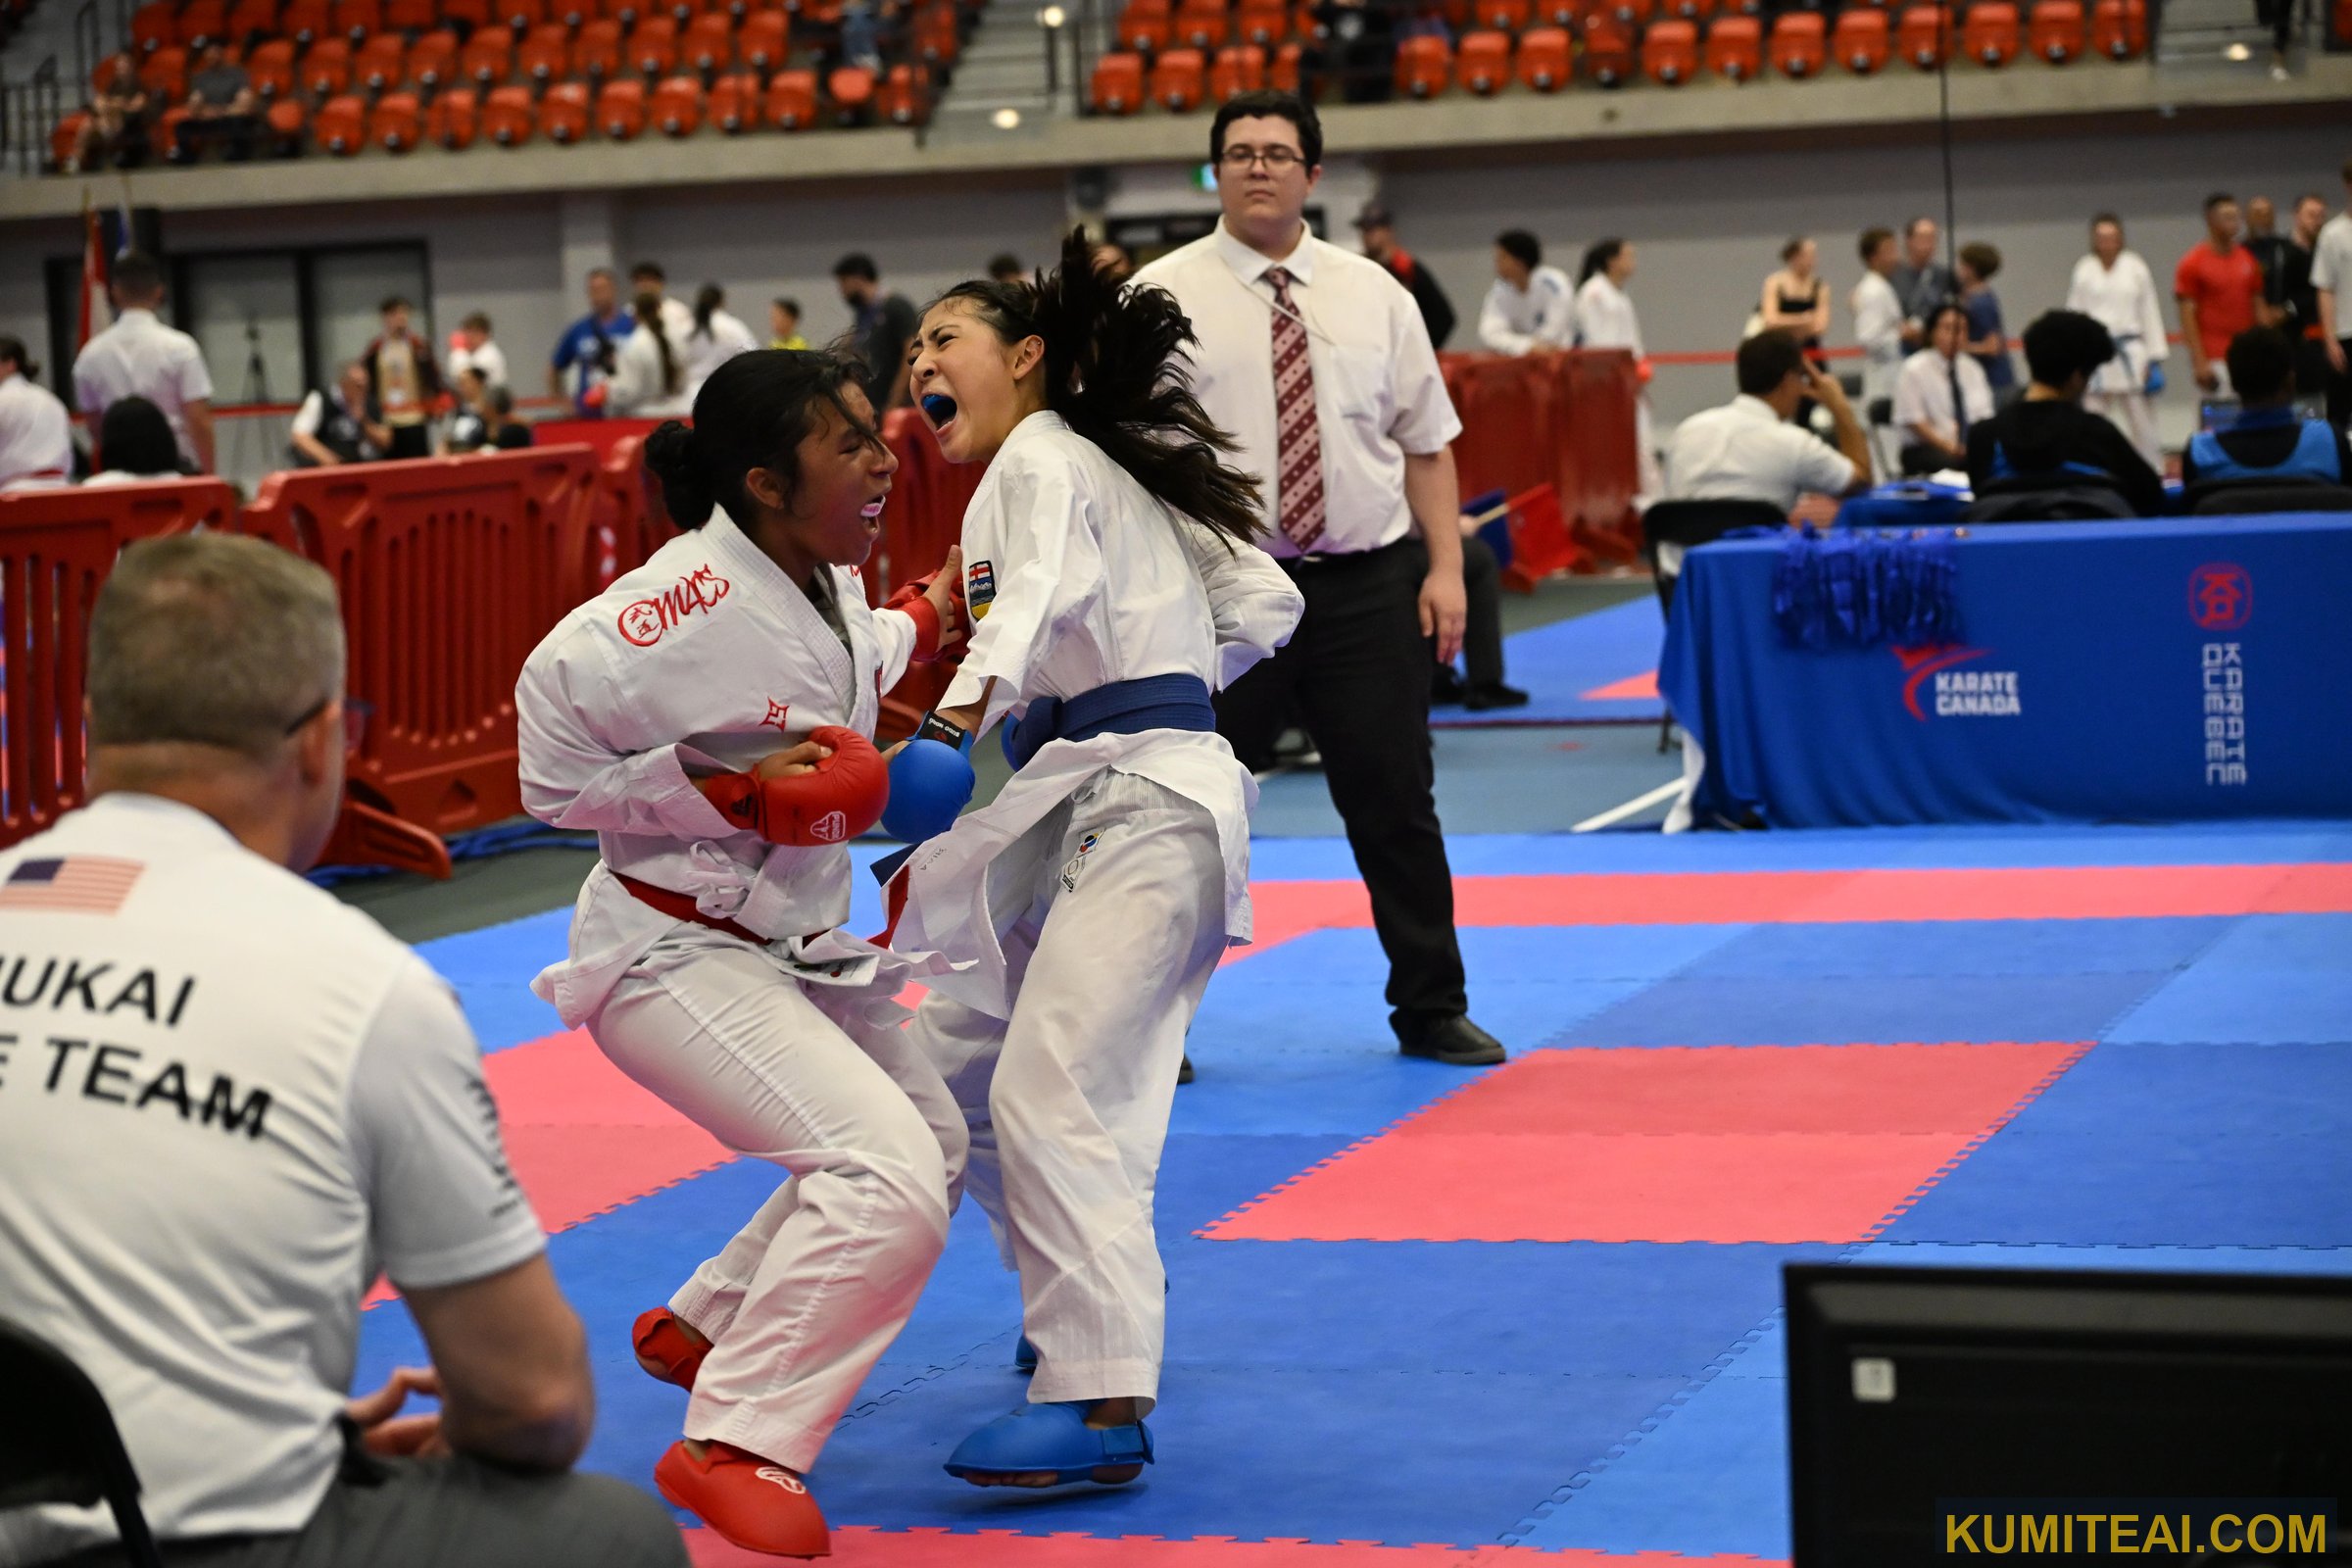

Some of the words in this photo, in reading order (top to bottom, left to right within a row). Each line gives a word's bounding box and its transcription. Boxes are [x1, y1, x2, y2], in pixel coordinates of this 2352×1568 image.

[1936, 671, 2019, 694] KARATE
[1936, 693, 2022, 716] CANADA
[0, 955, 195, 1027] UKAI
[45, 1036, 272, 1140] TEAM
